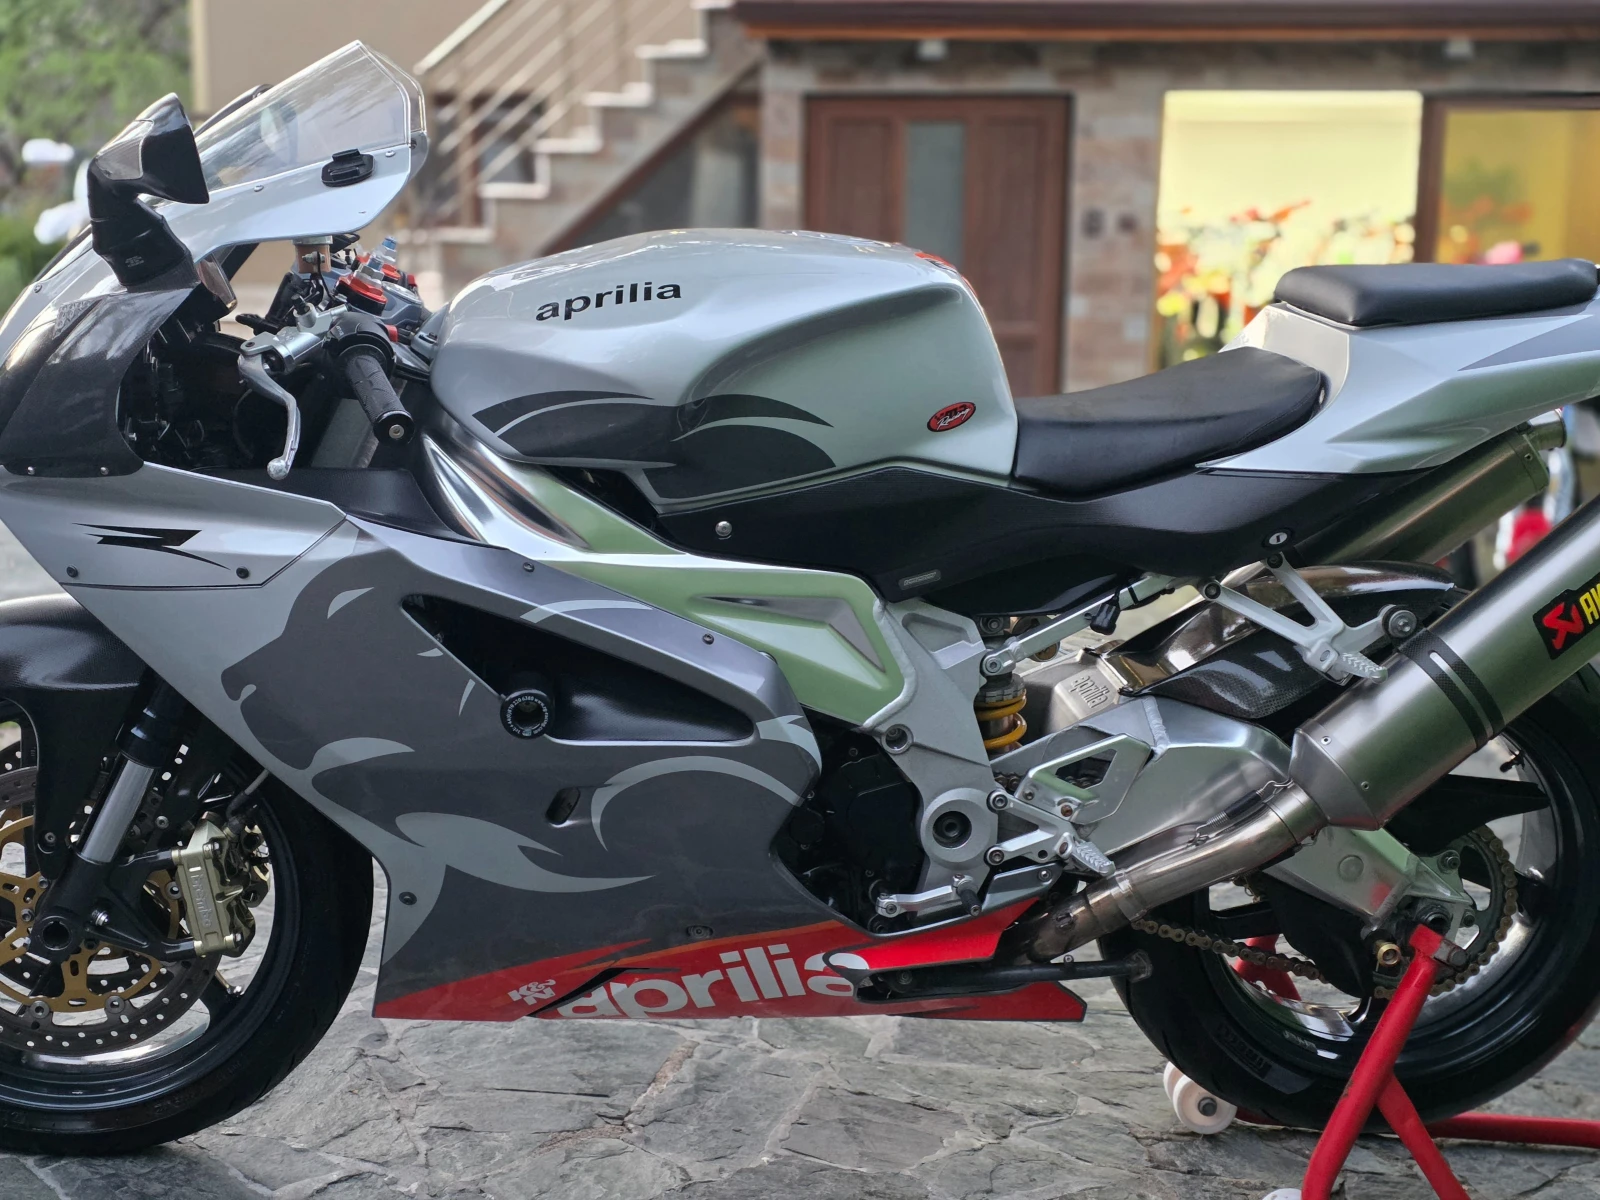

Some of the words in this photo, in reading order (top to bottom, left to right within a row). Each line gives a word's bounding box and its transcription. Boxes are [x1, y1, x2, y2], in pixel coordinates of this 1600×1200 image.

[535, 281, 682, 322] aprilia
[1070, 675, 1110, 709] aprilia
[507, 979, 556, 1006] K&N
[557, 943, 870, 1019] aprilia
